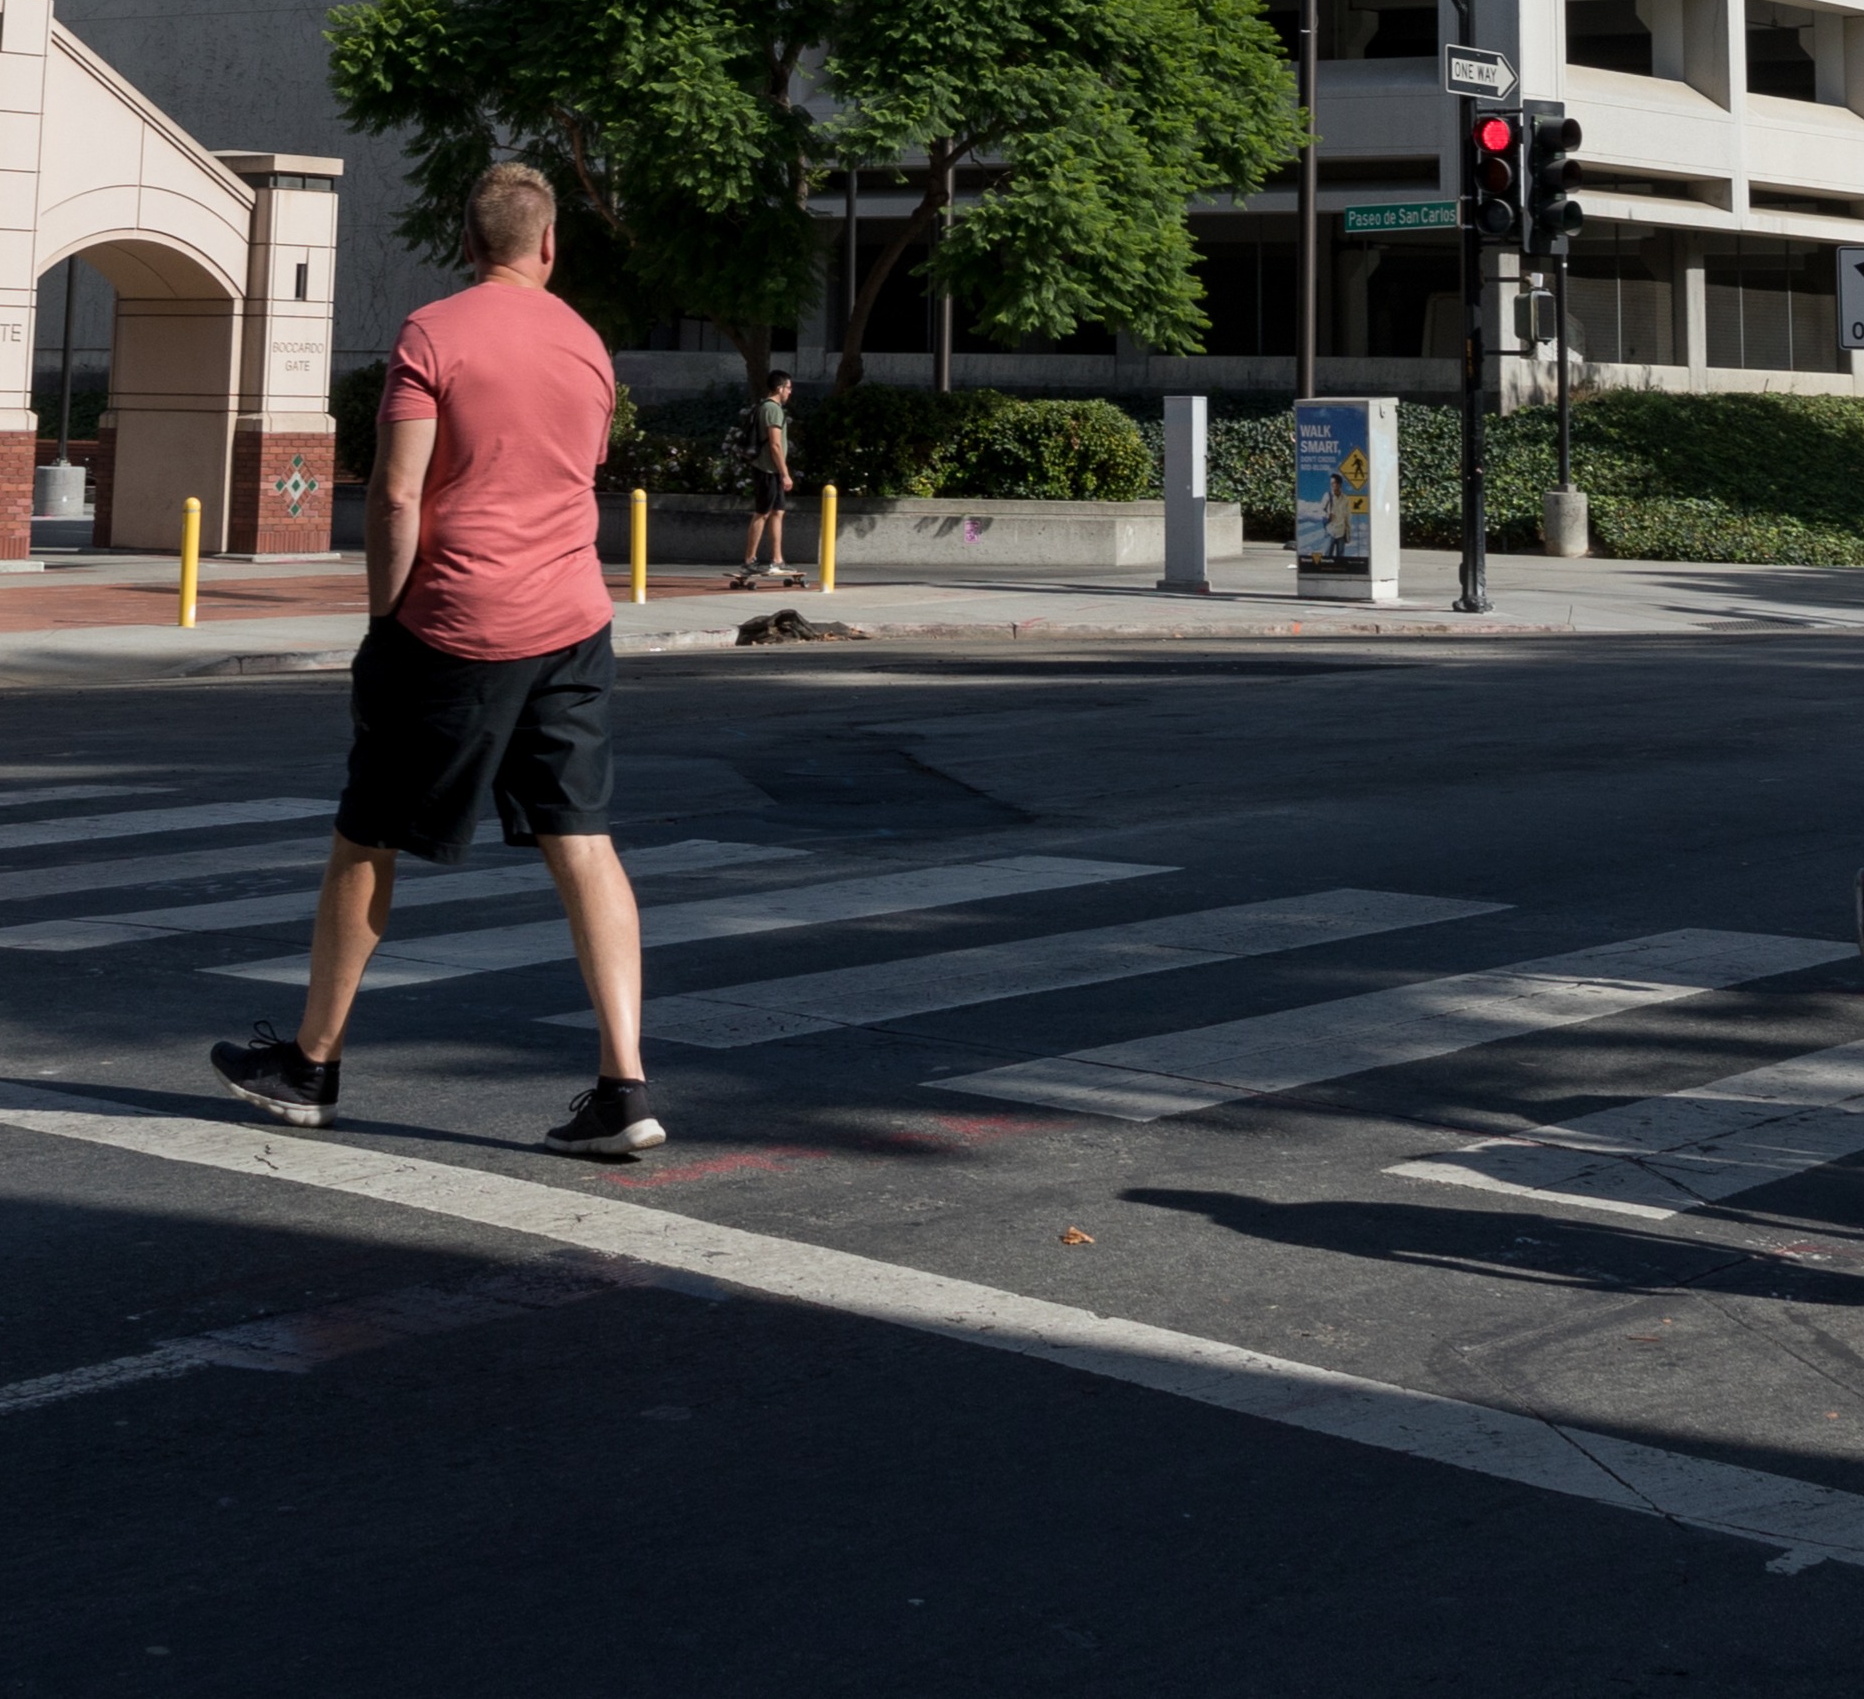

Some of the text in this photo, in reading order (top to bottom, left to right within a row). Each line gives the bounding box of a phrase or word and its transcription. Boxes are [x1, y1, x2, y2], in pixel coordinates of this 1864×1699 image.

[1454, 61, 1497, 84] ONE WAY
[1348, 206, 1456, 227] Paseo de San Carlos
[272, 341, 325, 354] BOCCARDO
[285, 360, 311, 371] GATE
[1300, 424, 1331, 438] WALK
[1300, 440, 1341, 456] SMART,
